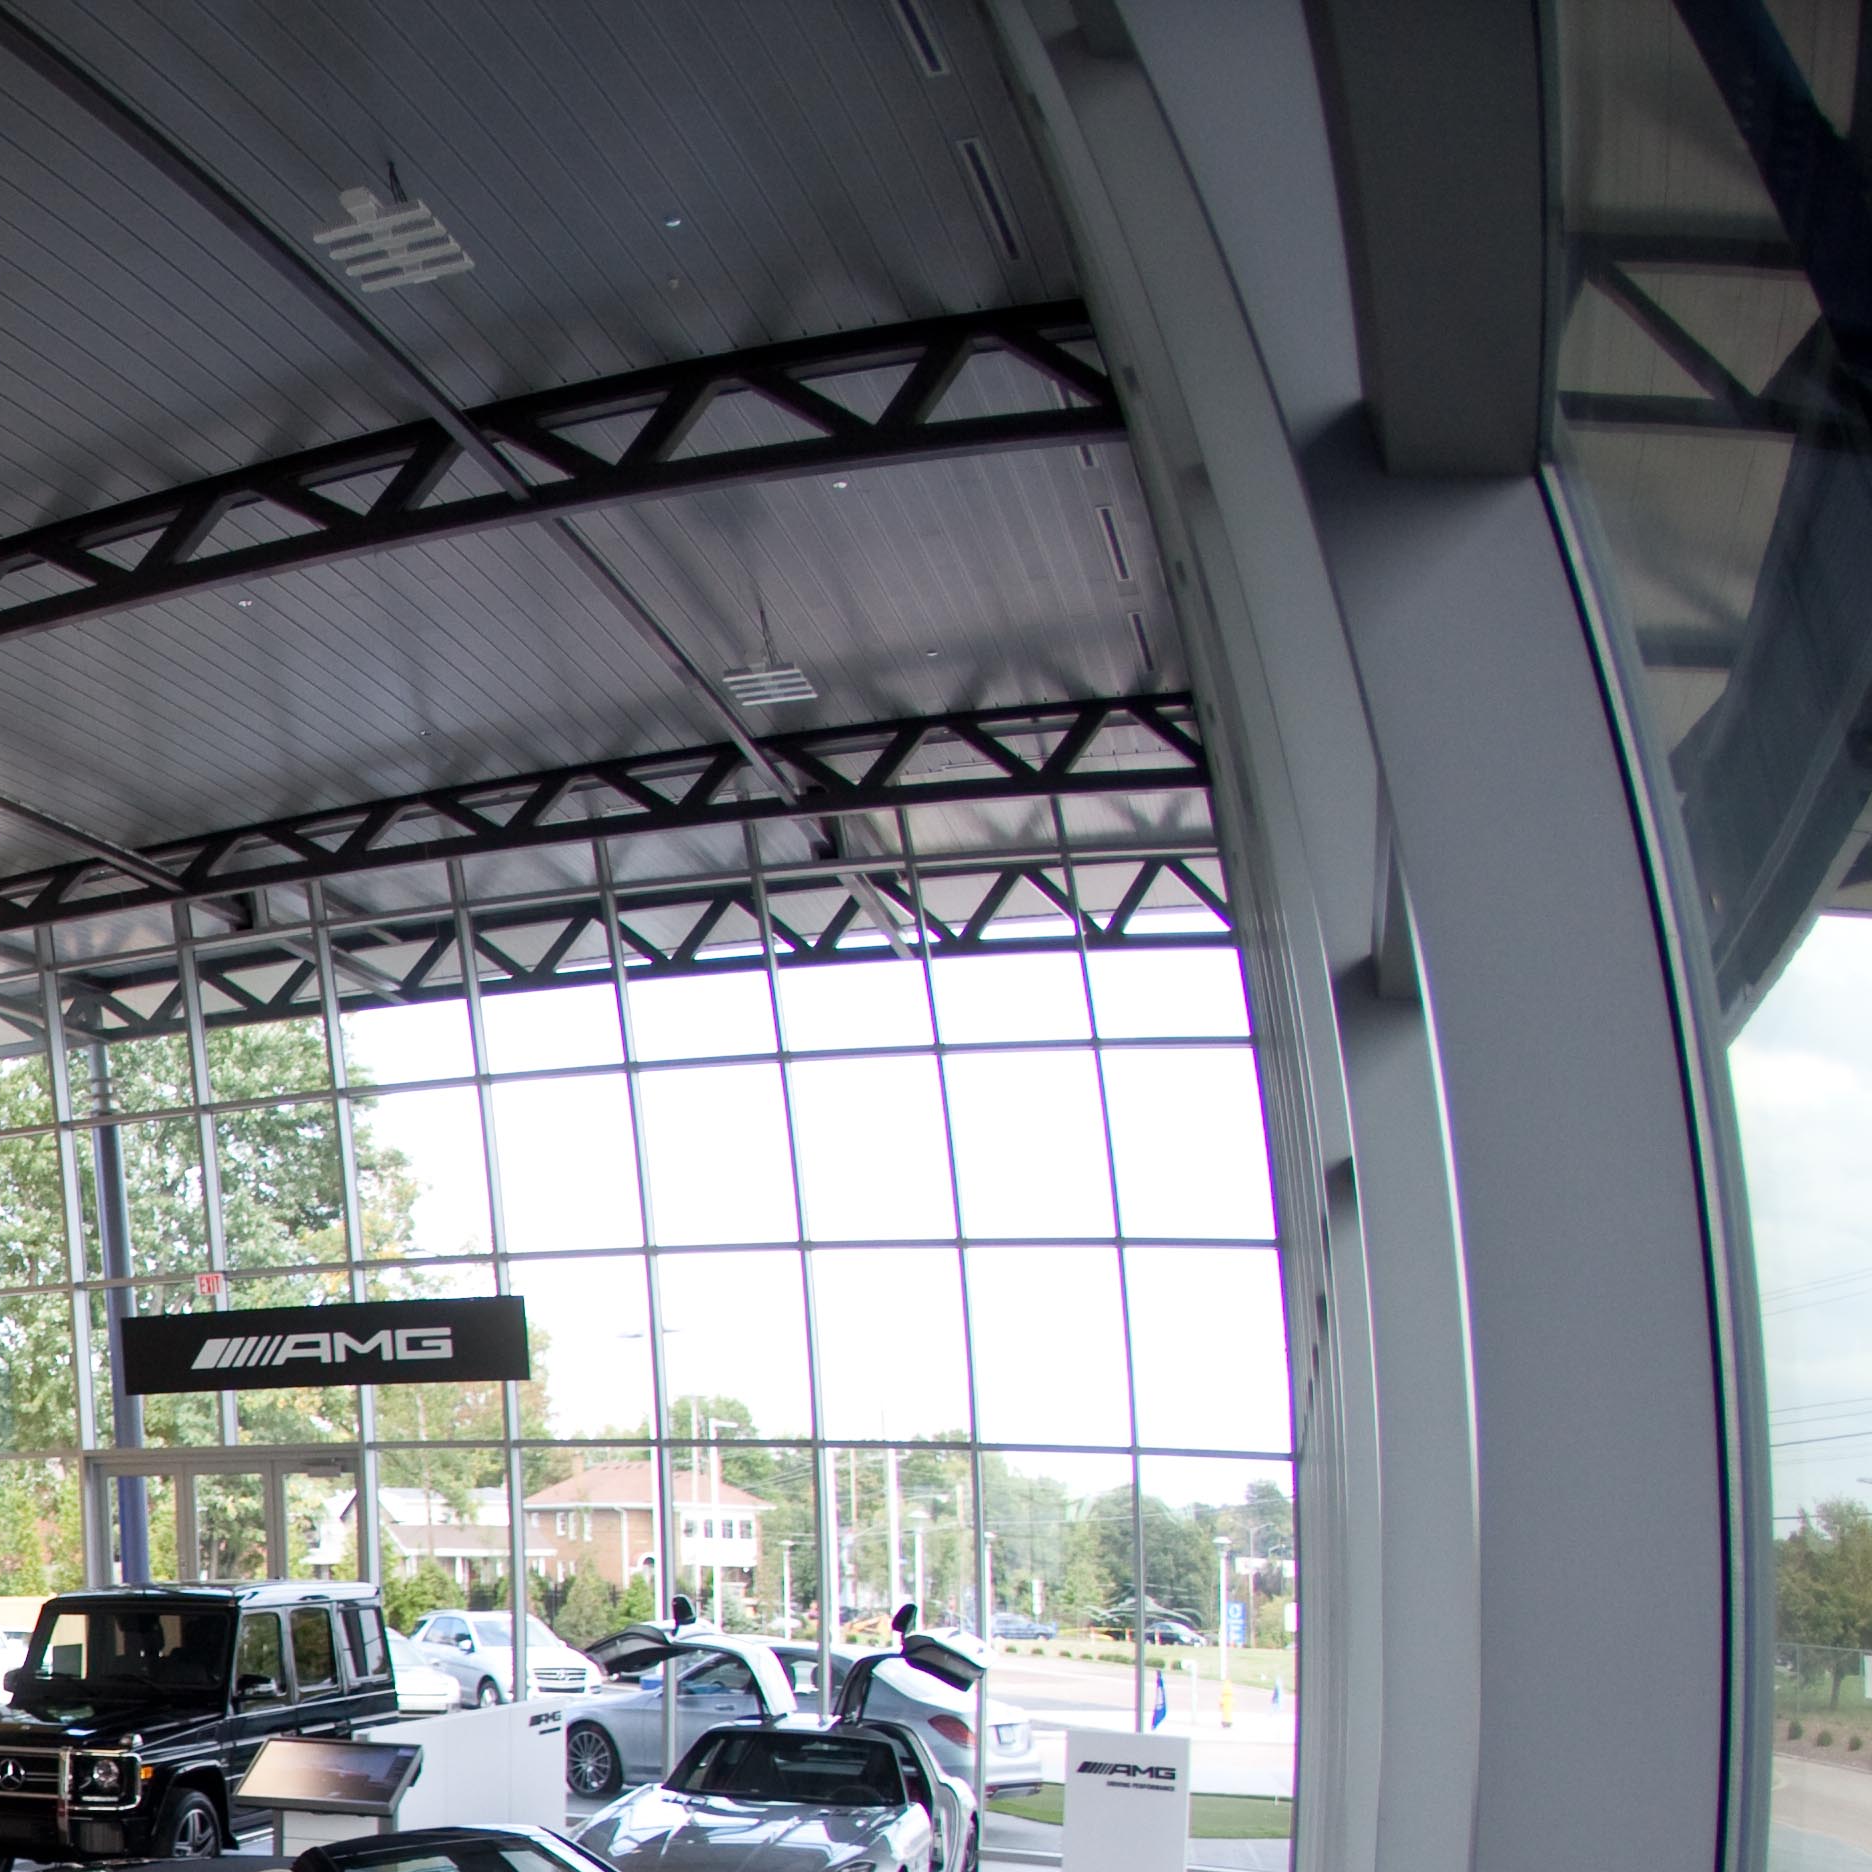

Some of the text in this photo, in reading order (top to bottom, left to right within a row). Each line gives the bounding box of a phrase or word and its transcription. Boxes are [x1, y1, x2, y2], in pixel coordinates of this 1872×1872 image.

[199, 1275, 221, 1295] EXIT
[272, 1327, 453, 1366] AMG
[1108, 1763, 1176, 1780] AMG
